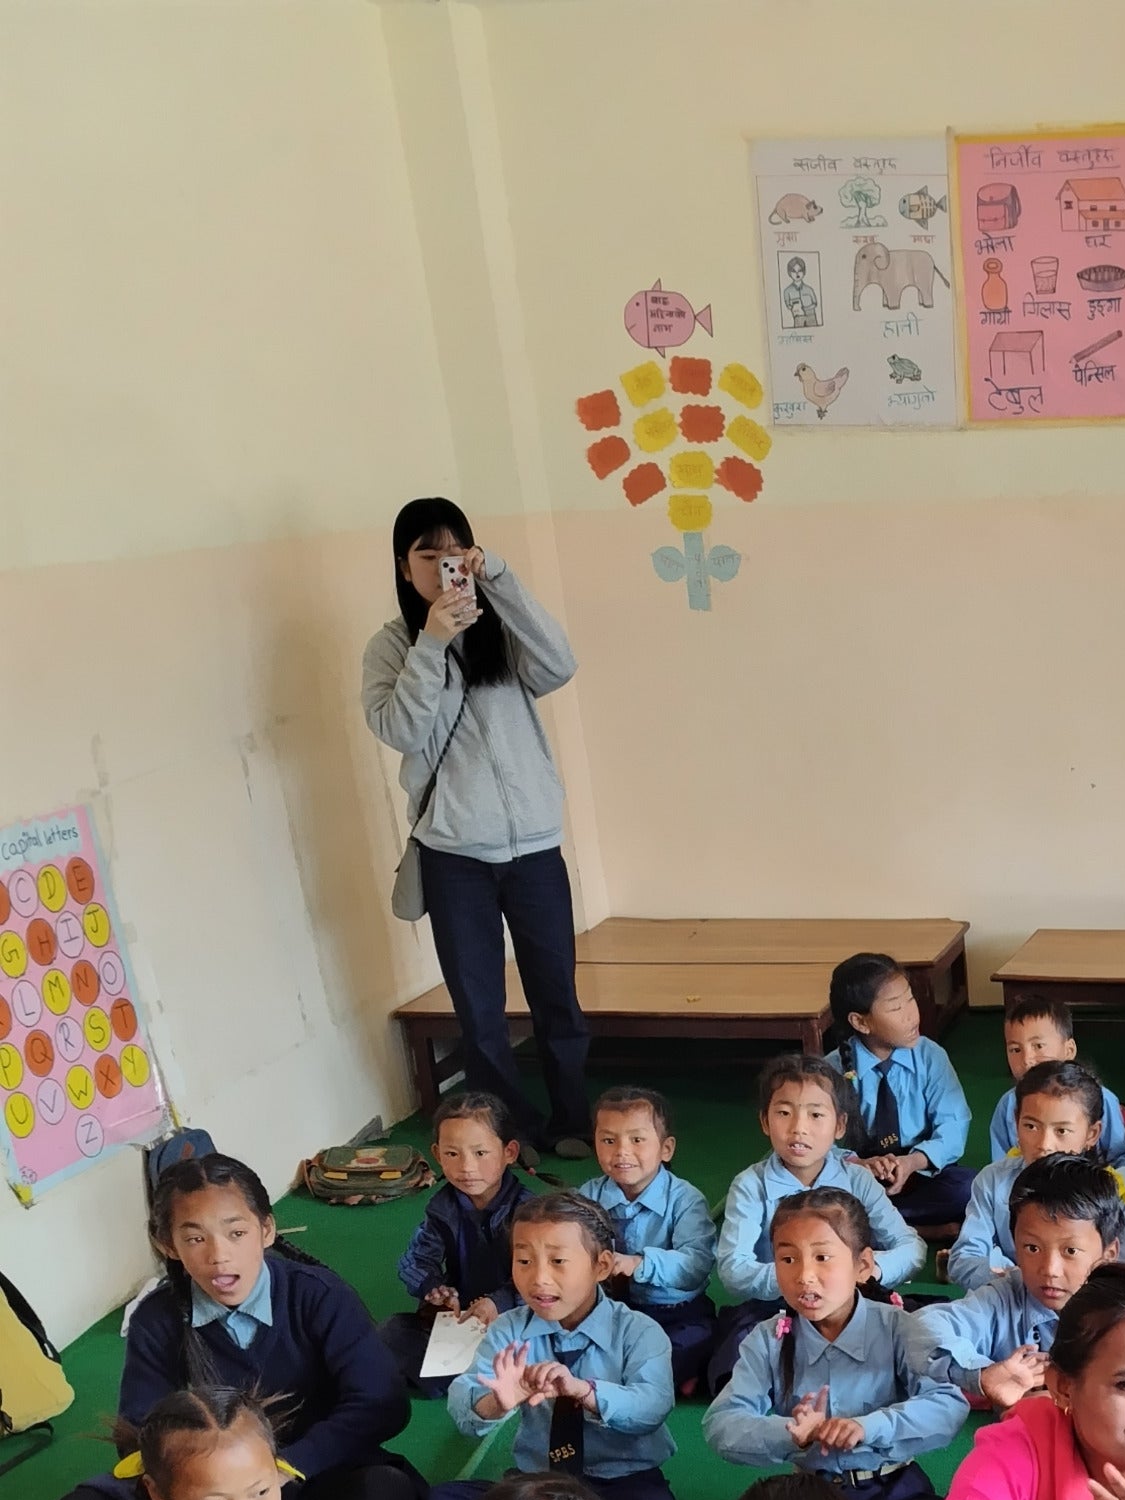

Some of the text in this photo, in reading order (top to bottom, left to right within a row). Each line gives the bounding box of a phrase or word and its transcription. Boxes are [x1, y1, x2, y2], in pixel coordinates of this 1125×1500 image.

[16, 866, 88, 902] C D E
[2, 908, 99, 963] G H I J
[18, 962, 116, 1016] L M N O
[0, 1002, 129, 1086] P Q R S T
[10, 1048, 136, 1124] U V W X Y
[81, 1122, 98, 1144] Z
[550, 1444, 576, 1462] SPBS
